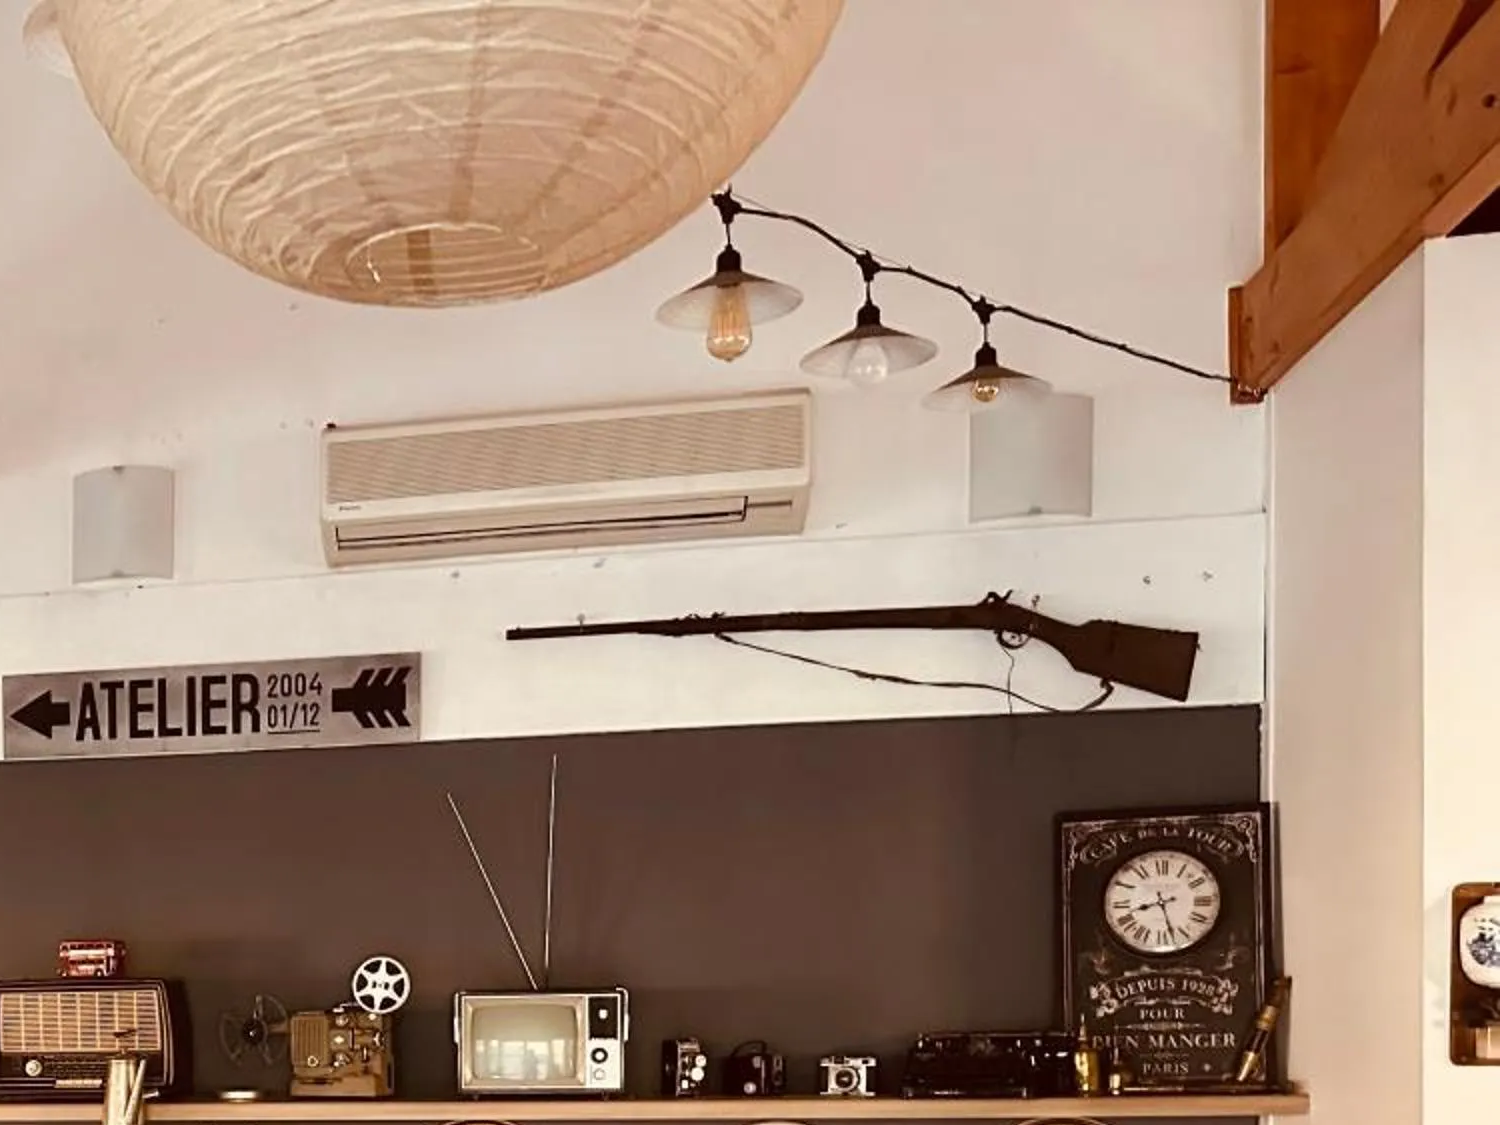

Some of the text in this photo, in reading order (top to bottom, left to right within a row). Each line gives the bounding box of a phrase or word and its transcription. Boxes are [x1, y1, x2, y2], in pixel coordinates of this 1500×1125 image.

[75, 672, 323, 742] ATELIER 2004
[266, 702, 321, 730] 01/12
[1115, 977, 1175, 1000] DEPUIS
[1139, 1008, 1186, 1020] POUR
[1149, 1033, 1236, 1049] MANGER
[1142, 1063, 1189, 1075] PARIS
